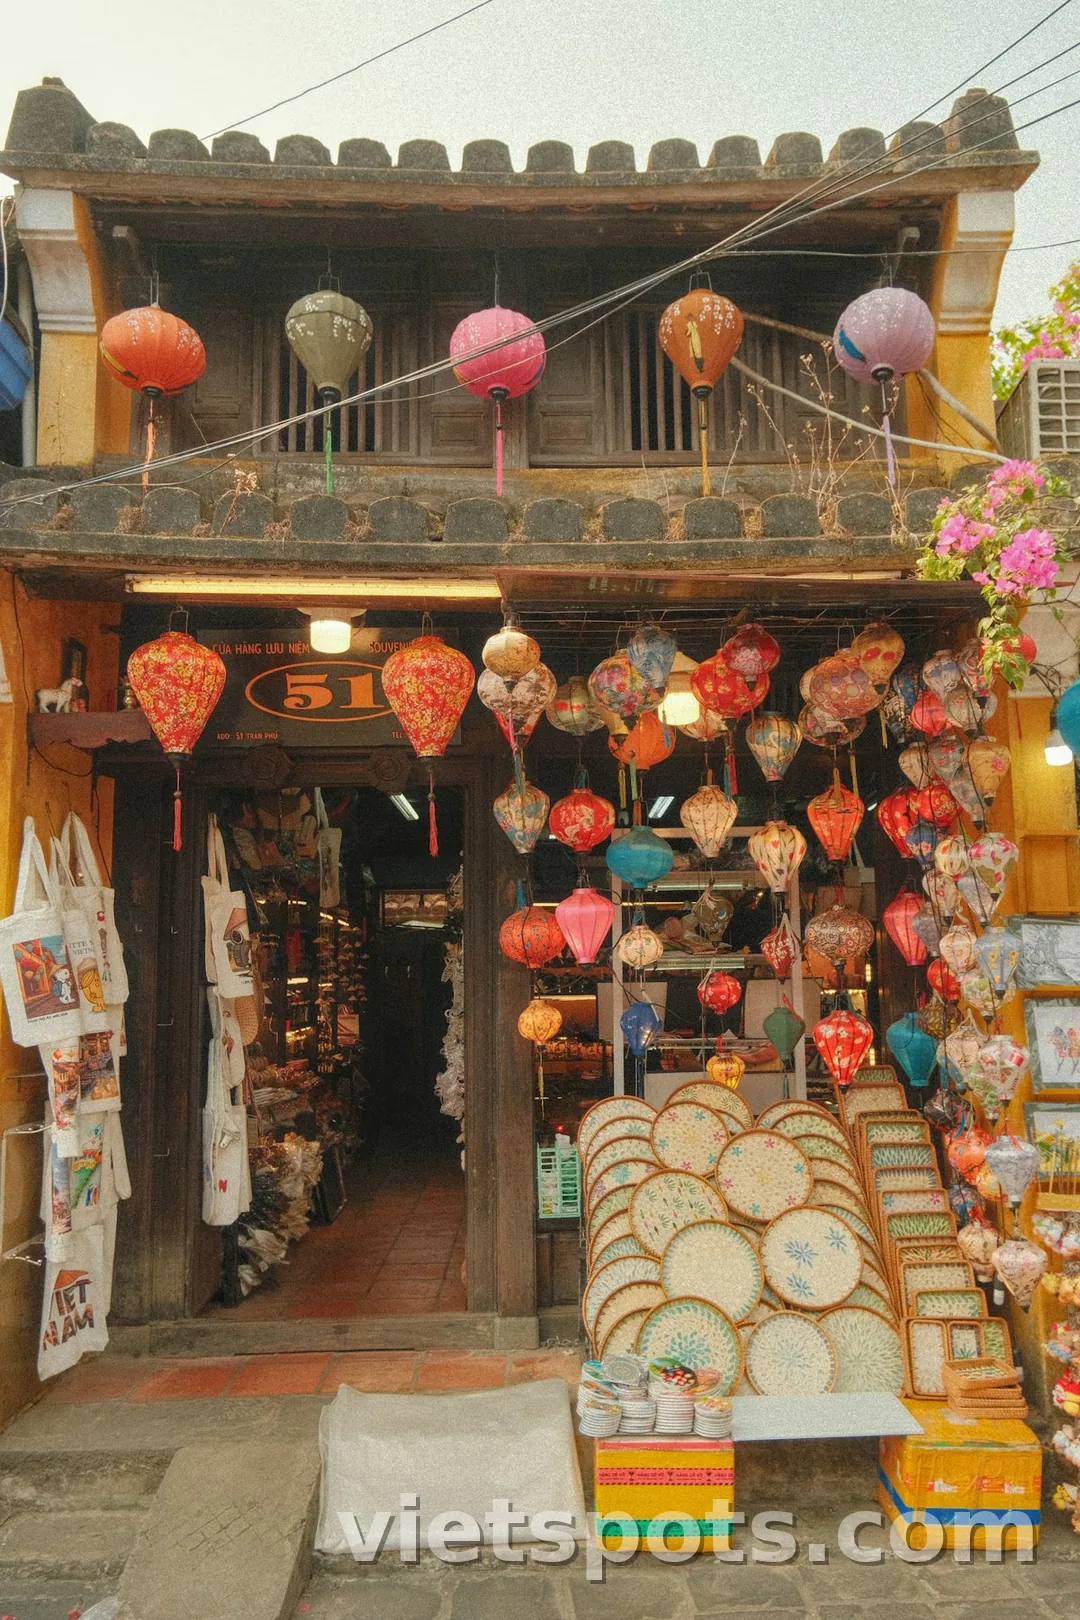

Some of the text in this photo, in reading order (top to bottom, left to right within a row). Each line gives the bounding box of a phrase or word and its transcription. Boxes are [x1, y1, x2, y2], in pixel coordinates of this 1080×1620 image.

[235, 641, 262, 654] HÀNG
[266, 641, 284, 654] LƯU
[288, 640, 310, 655] NIỆM
[283, 672, 385, 710] 51
[235, 731, 244, 740] 51
[264, 730, 279, 740] PHÚ
[49, 1279, 93, 1319] IET
[43, 1303, 95, 1351] NAM
